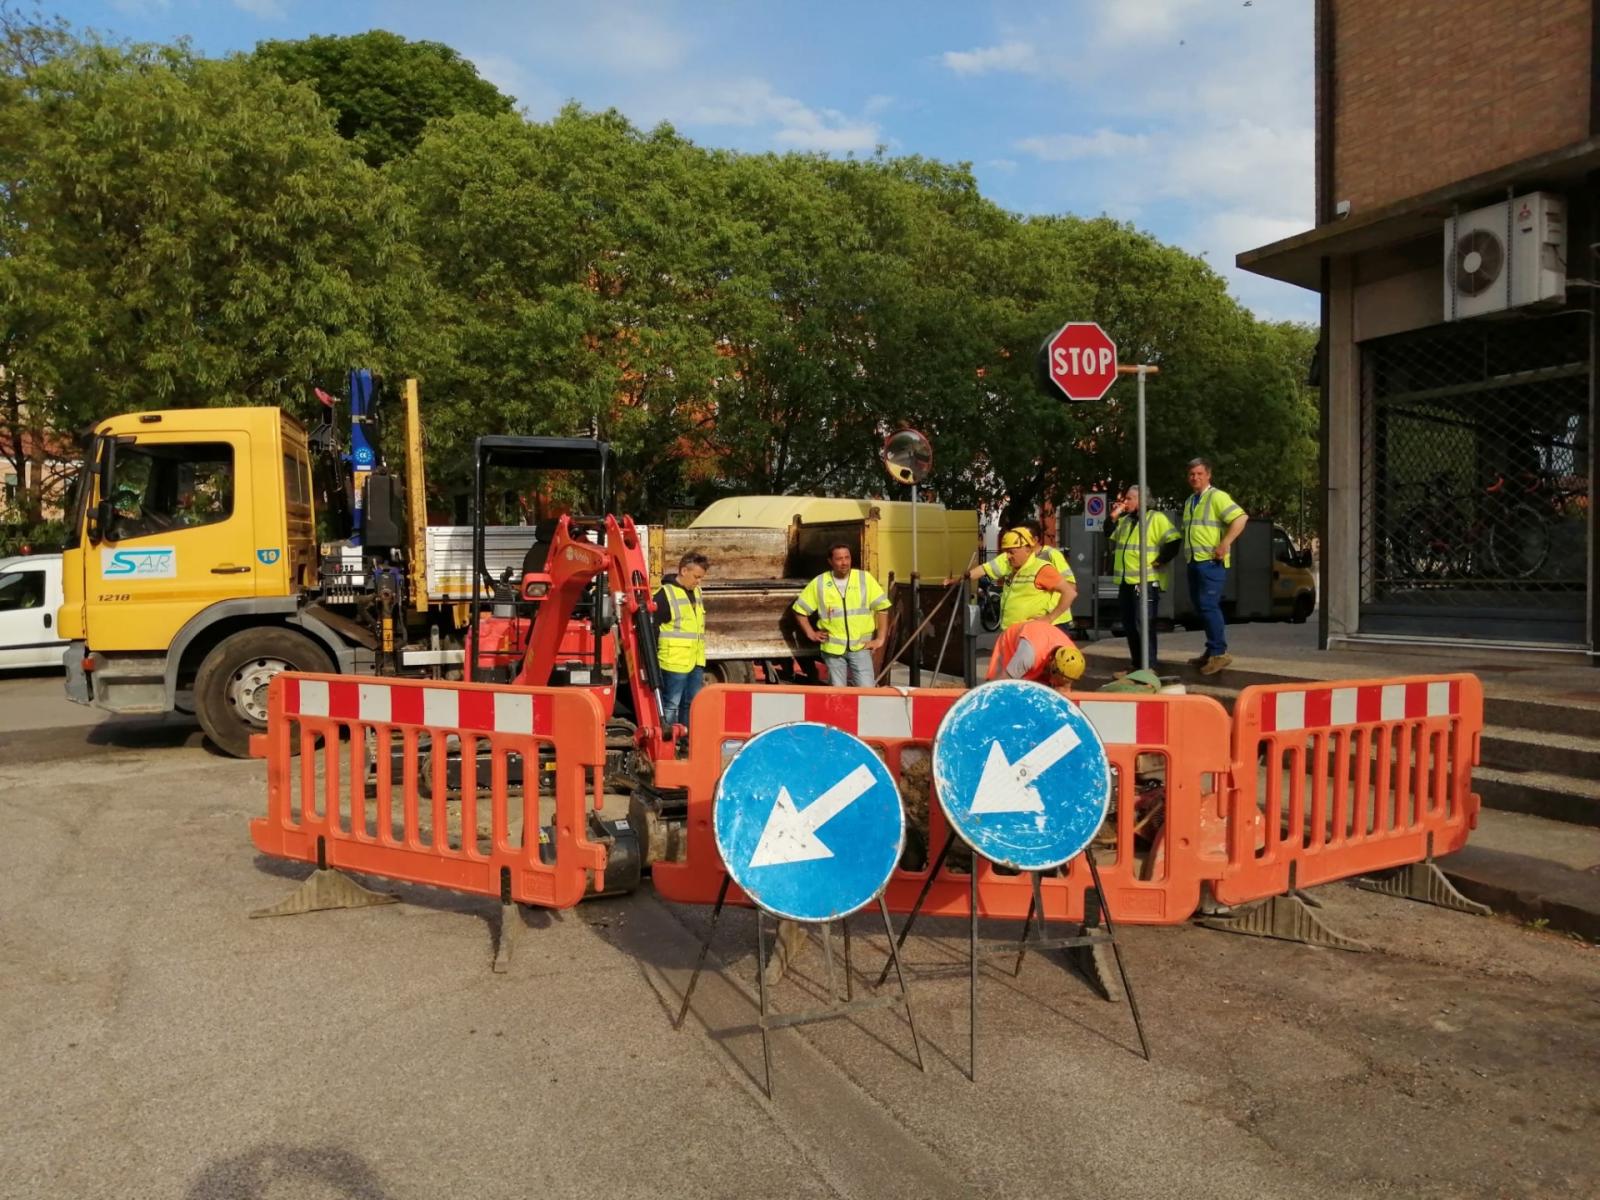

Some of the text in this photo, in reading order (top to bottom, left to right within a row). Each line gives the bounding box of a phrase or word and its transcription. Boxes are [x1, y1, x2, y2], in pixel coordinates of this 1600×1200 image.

[1054, 347, 1112, 375] STOP
[104, 550, 173, 574] SAR
[98, 593, 130, 602] 1218
